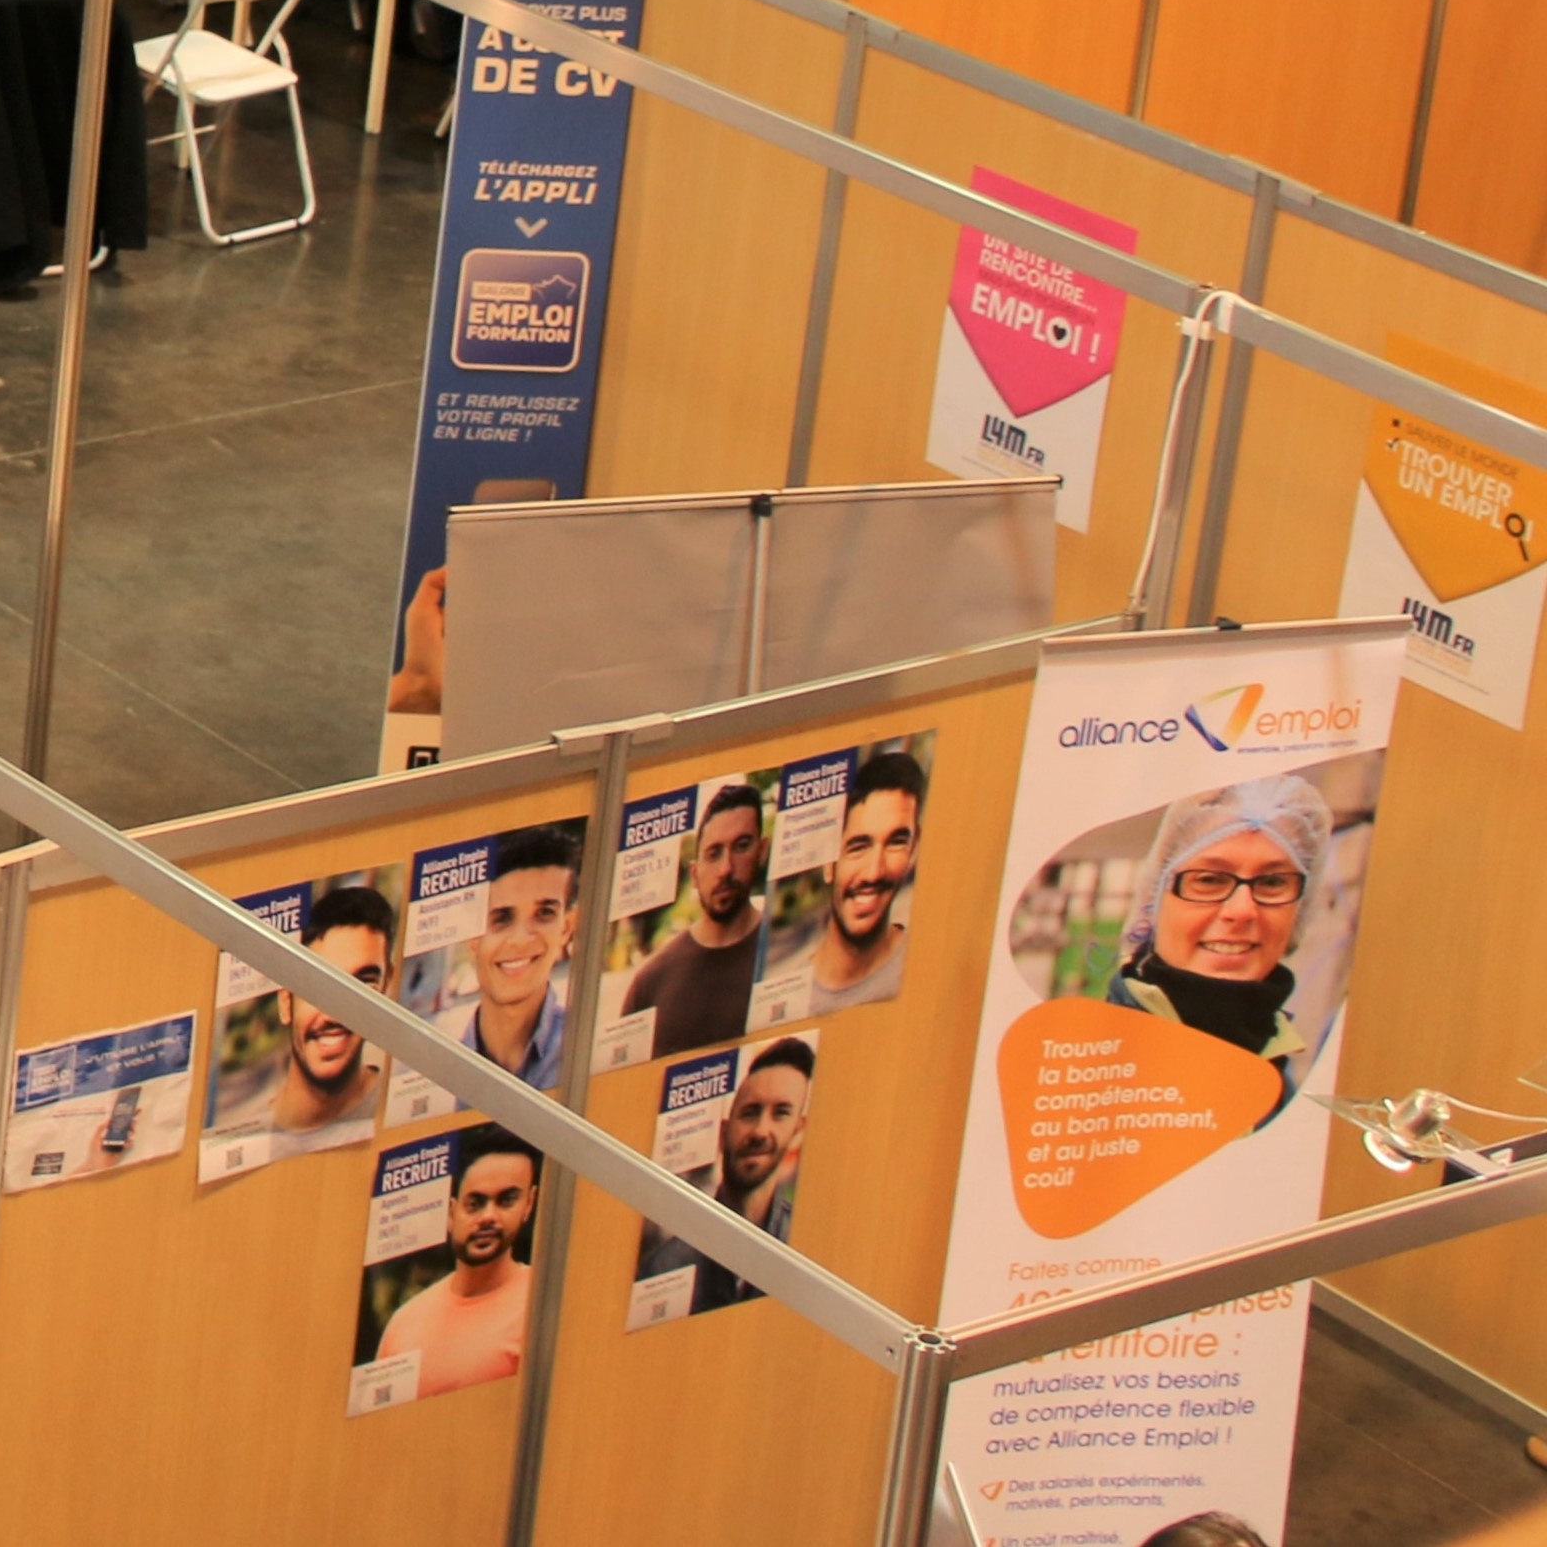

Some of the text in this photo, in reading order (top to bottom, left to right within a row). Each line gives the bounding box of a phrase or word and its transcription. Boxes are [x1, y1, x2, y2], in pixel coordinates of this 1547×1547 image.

[579, 4, 627, 23] PLUS
[471, 57, 621, 98] DE CV
[478, 159, 597, 180] TÉLÉCHARGEZ
[475, 180, 598, 206] L'APPLI
[467, 302, 574, 329] EMPLOI
[970, 282, 1084, 356] EMPLOI
[466, 325, 571, 345] FORMATION
[437, 394, 581, 412] ET REMPLISSEZ
[436, 409, 563, 428] VOTRE PROFIL
[433, 424, 520, 443] EN LIGNE
[1398, 464, 1434, 499] UN
[1400, 440, 1514, 506] TROUVER
[1058, 699, 1363, 750] alliance emploi
[785, 772, 848, 809] RECRUTE
[625, 811, 688, 847] RECRUTE
[419, 860, 488, 898] RECRUTE
[1042, 1036, 1122, 1059] Trouver
[1038, 1059, 1137, 1086] la bonne
[667, 1074, 729, 1109] RECRUTE
[1034, 1083, 1186, 1113] compétence,
[1031, 1110, 1219, 1137] au bon moment,
[1027, 1135, 1141, 1164] et au juste
[381, 1155, 450, 1193] RECRUTE
[1023, 1166, 1075, 1190] coût
[1008, 1255, 1162, 1282] Faites comme
[993, 1370, 1241, 1398] mutualisez vos besoins
[989, 1397, 1256, 1426] de compétence flexible
[985, 1428, 1219, 1455] avec Alliance Emploi
[1009, 1476, 1035, 1492] Des
[1038, 1473, 1094, 1491] salariés
